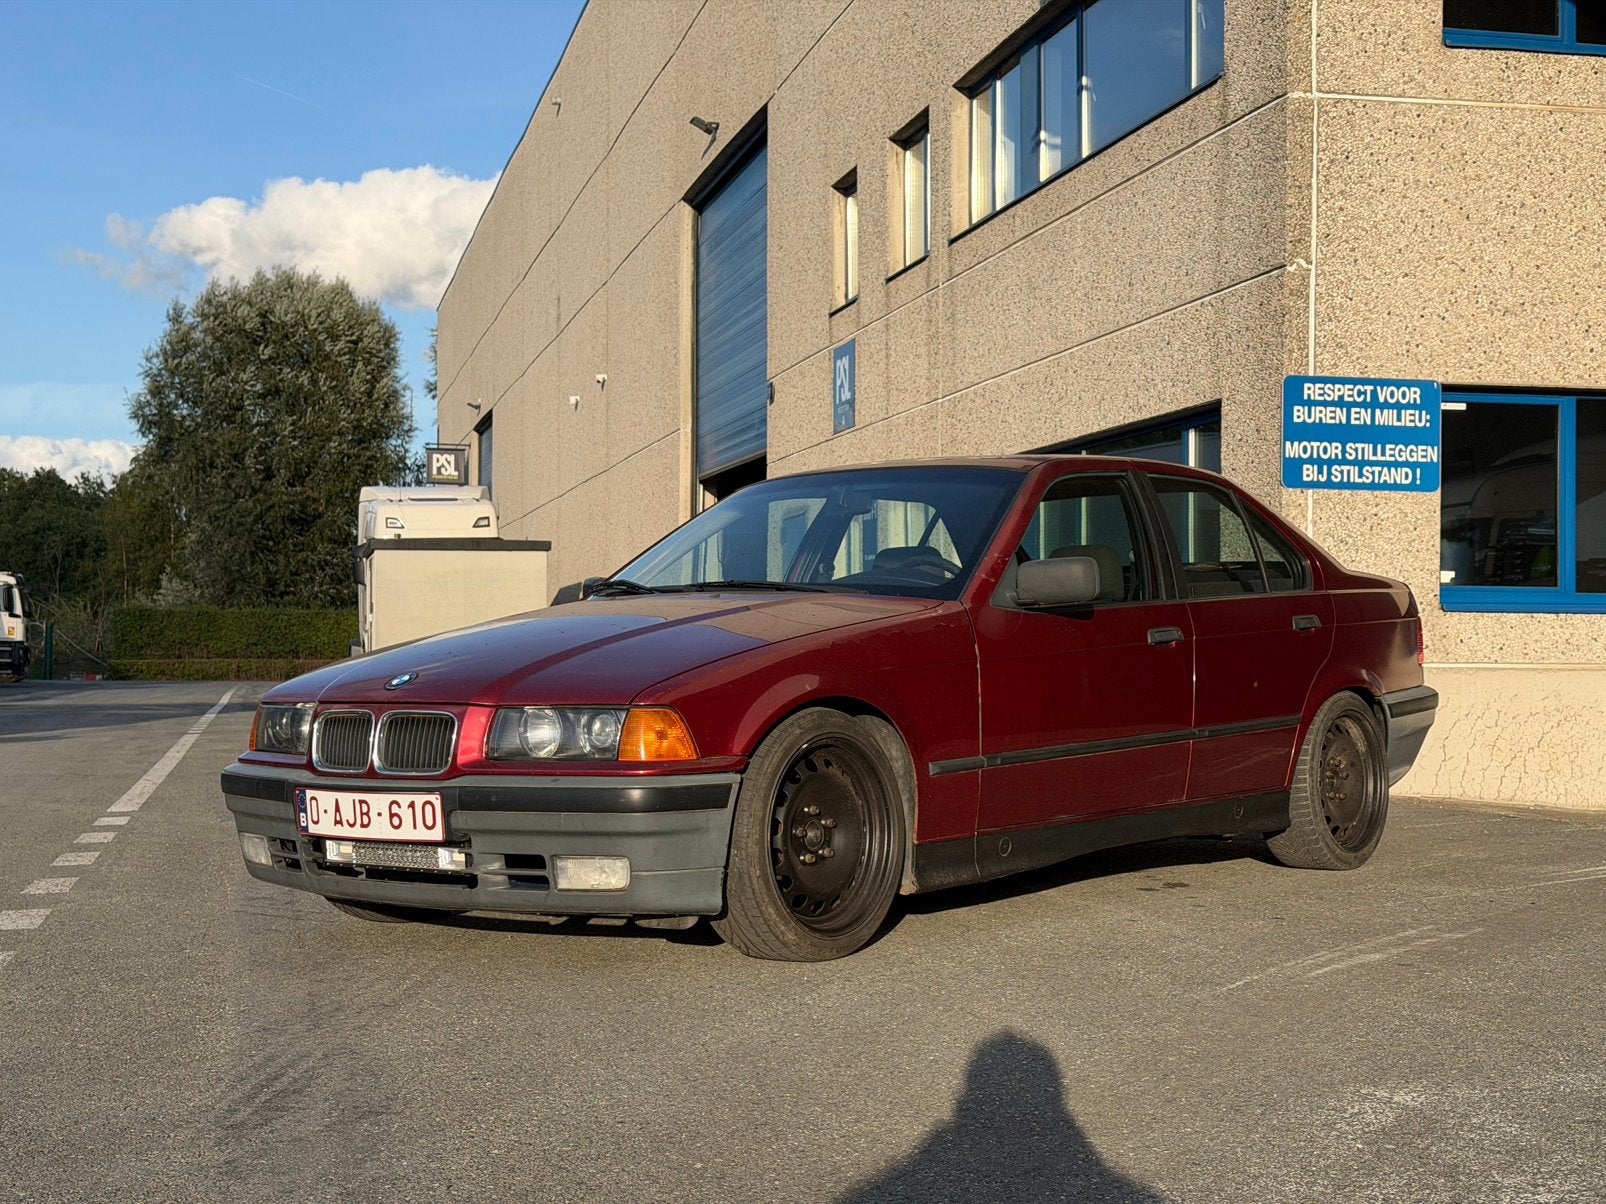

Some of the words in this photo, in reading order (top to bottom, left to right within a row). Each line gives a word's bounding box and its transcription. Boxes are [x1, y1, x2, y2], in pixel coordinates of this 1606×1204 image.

[836, 355, 851, 404] PSL
[1303, 383, 1375, 402] RESPECT
[1377, 386, 1421, 404] VOOR
[1293, 405, 1349, 424] BUREN
[1350, 408, 1372, 425] EN
[1375, 409, 1431, 427] MILIEU:
[1285, 441, 1343, 460] MOTOR
[1345, 443, 1439, 463] STILLEGGEN
[432, 453, 459, 476] PSL
[1302, 464, 1328, 482] BIJ
[1331, 466, 1413, 485] STILSTAND
[300, 813, 307, 827] B
